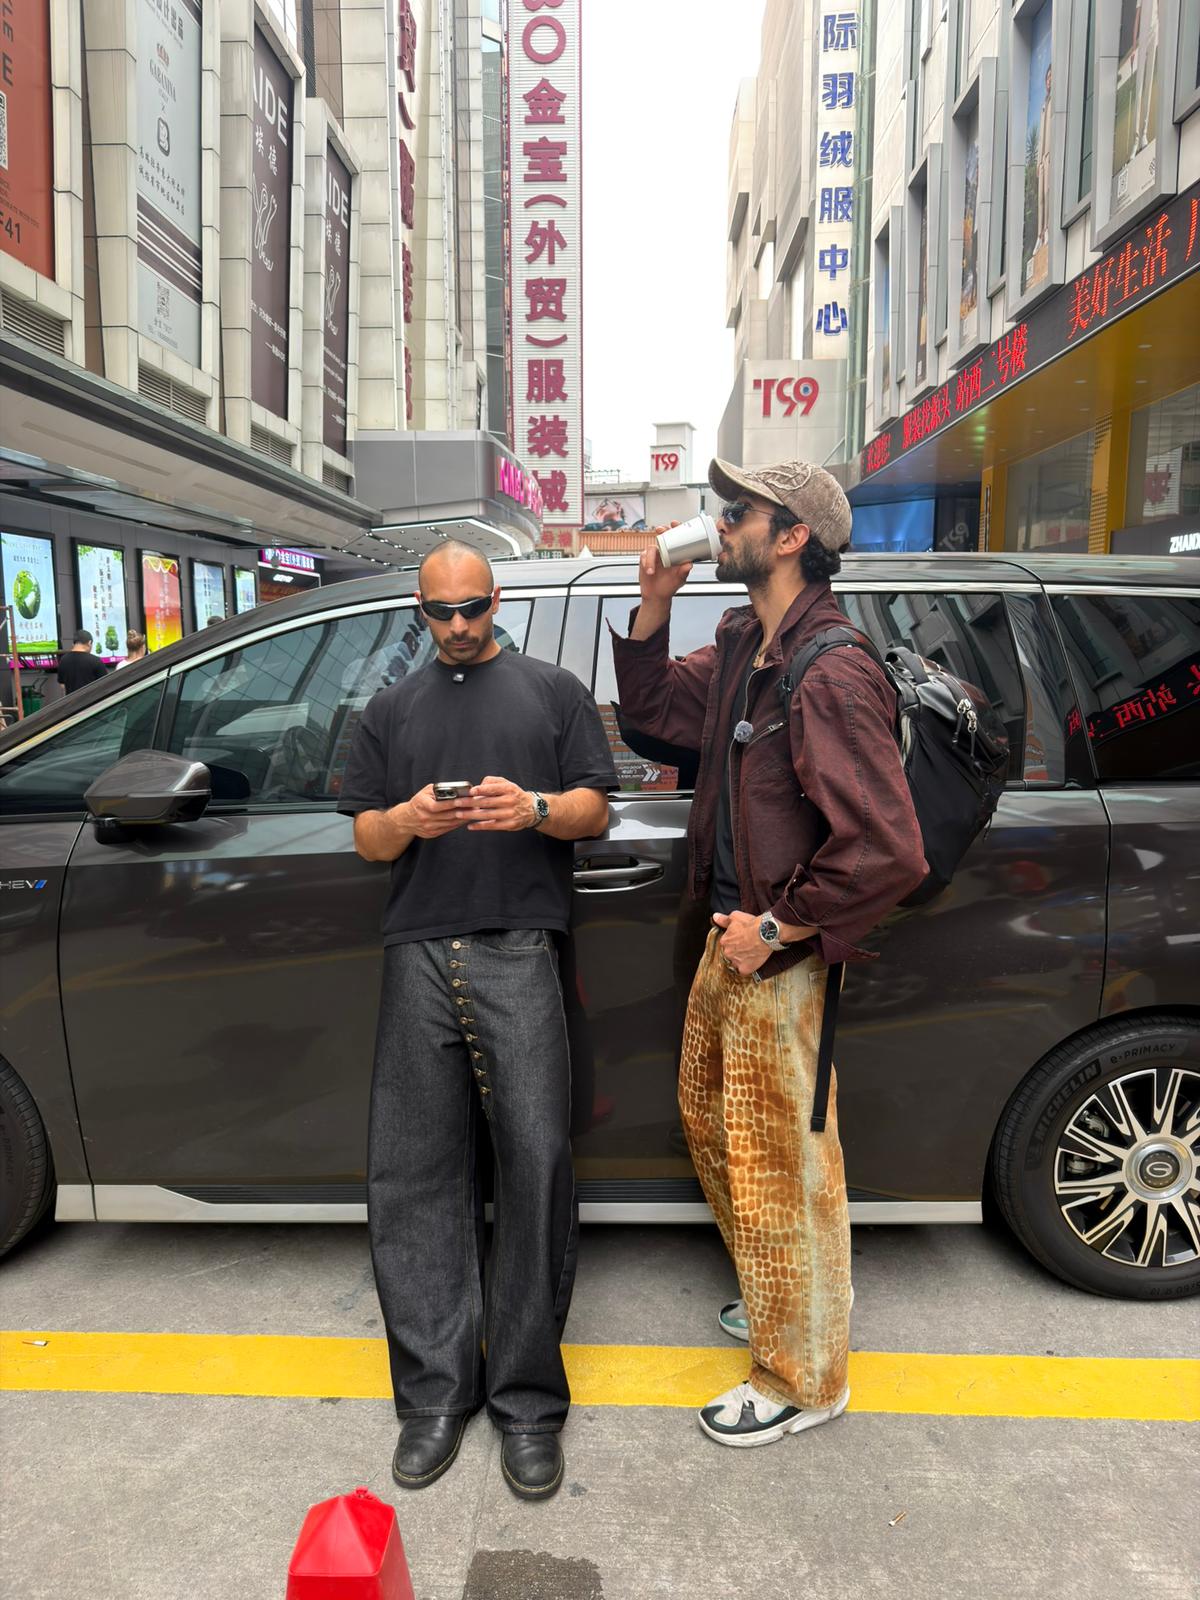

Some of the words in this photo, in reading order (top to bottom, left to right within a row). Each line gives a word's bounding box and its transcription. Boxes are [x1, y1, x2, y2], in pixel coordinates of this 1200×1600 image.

[815, 12, 859, 337] 际羽绒服中心
[1066, 213, 1173, 341] 美好生活
